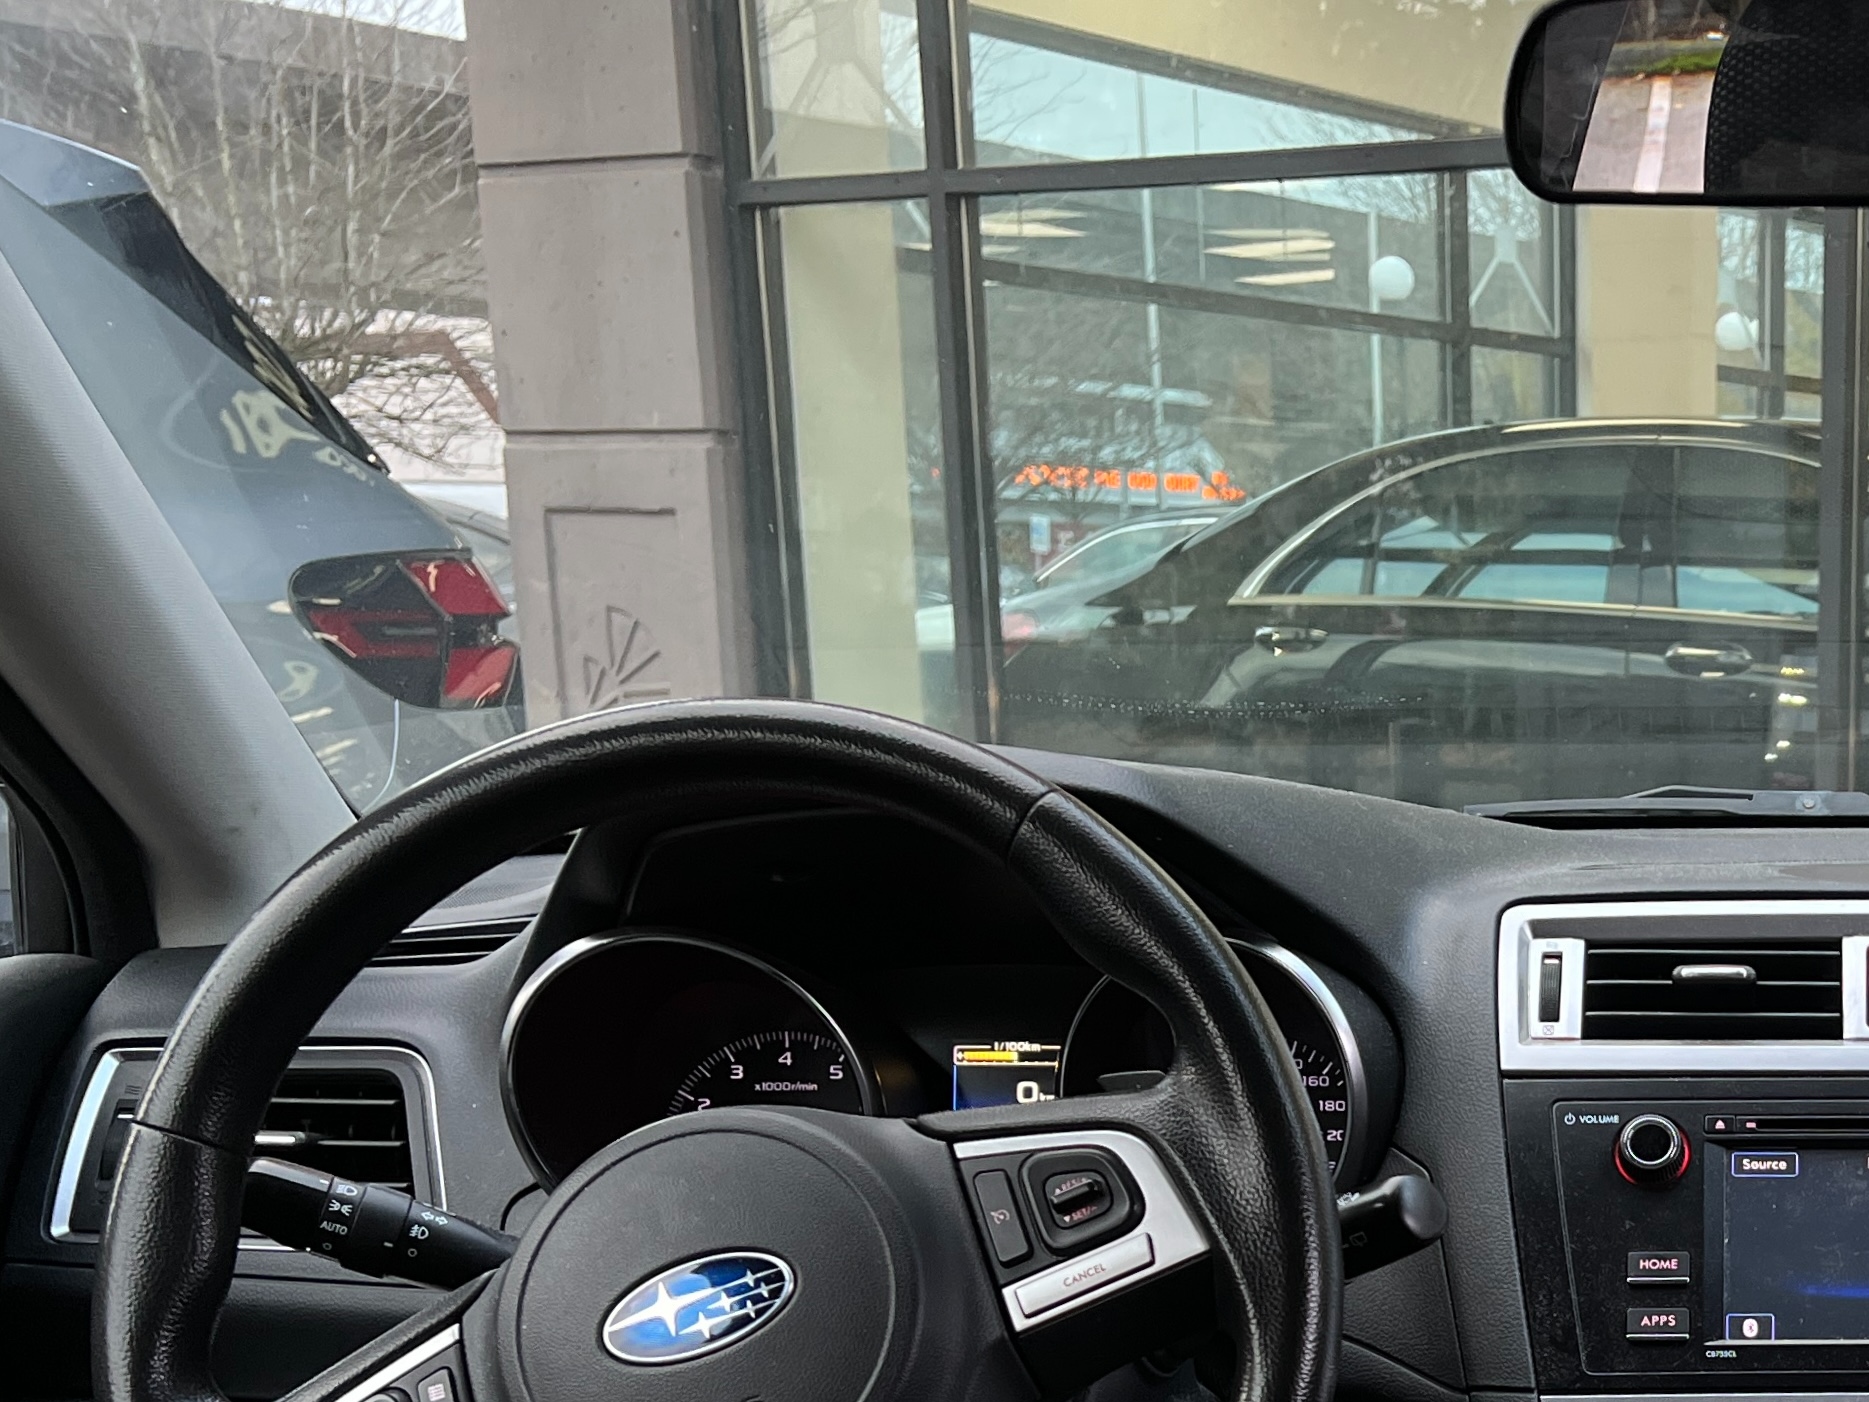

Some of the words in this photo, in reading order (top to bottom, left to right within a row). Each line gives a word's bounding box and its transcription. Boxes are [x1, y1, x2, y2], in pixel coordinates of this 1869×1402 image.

[778, 1052, 792, 1066] 4
[730, 1065, 744, 1079] 3
[829, 1065, 843, 1079] 5
[1016, 1081, 1038, 1104] 0
[1319, 1100, 1346, 1111] 180
[1579, 1115, 1620, 1124] VOLUME
[1742, 1158, 1787, 1170] Source
[320, 1221, 348, 1235] AUTO
[1639, 1258, 1679, 1269] HOME
[1062, 1263, 1107, 1287] CANCEL
[1640, 1315, 1676, 1327] APPS
